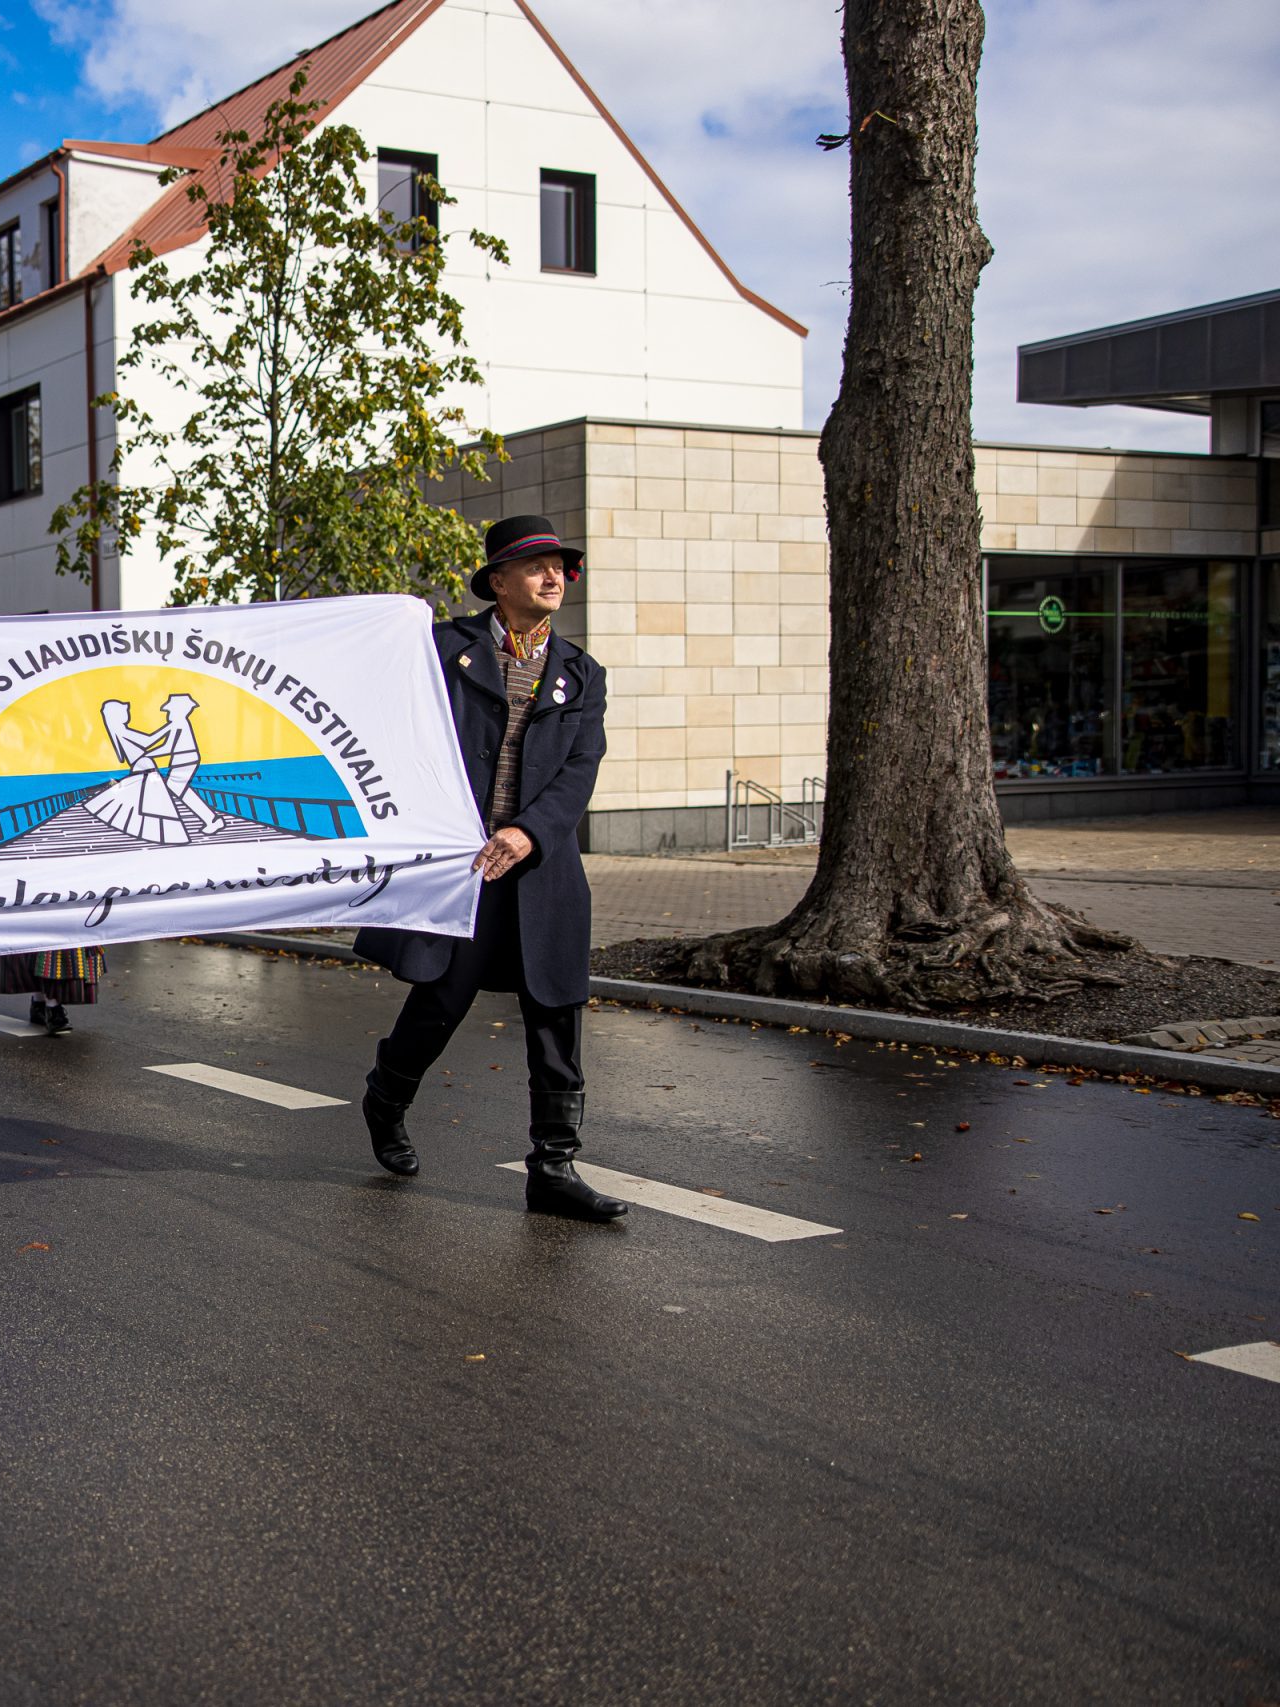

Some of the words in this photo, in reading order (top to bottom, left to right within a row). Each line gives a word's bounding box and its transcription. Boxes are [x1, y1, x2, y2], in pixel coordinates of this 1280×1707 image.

[8, 624, 174, 680] LIAUDIŠKŲ
[182, 628, 277, 690] ŠOKIŲ
[274, 674, 399, 820] FESTIVALIS
